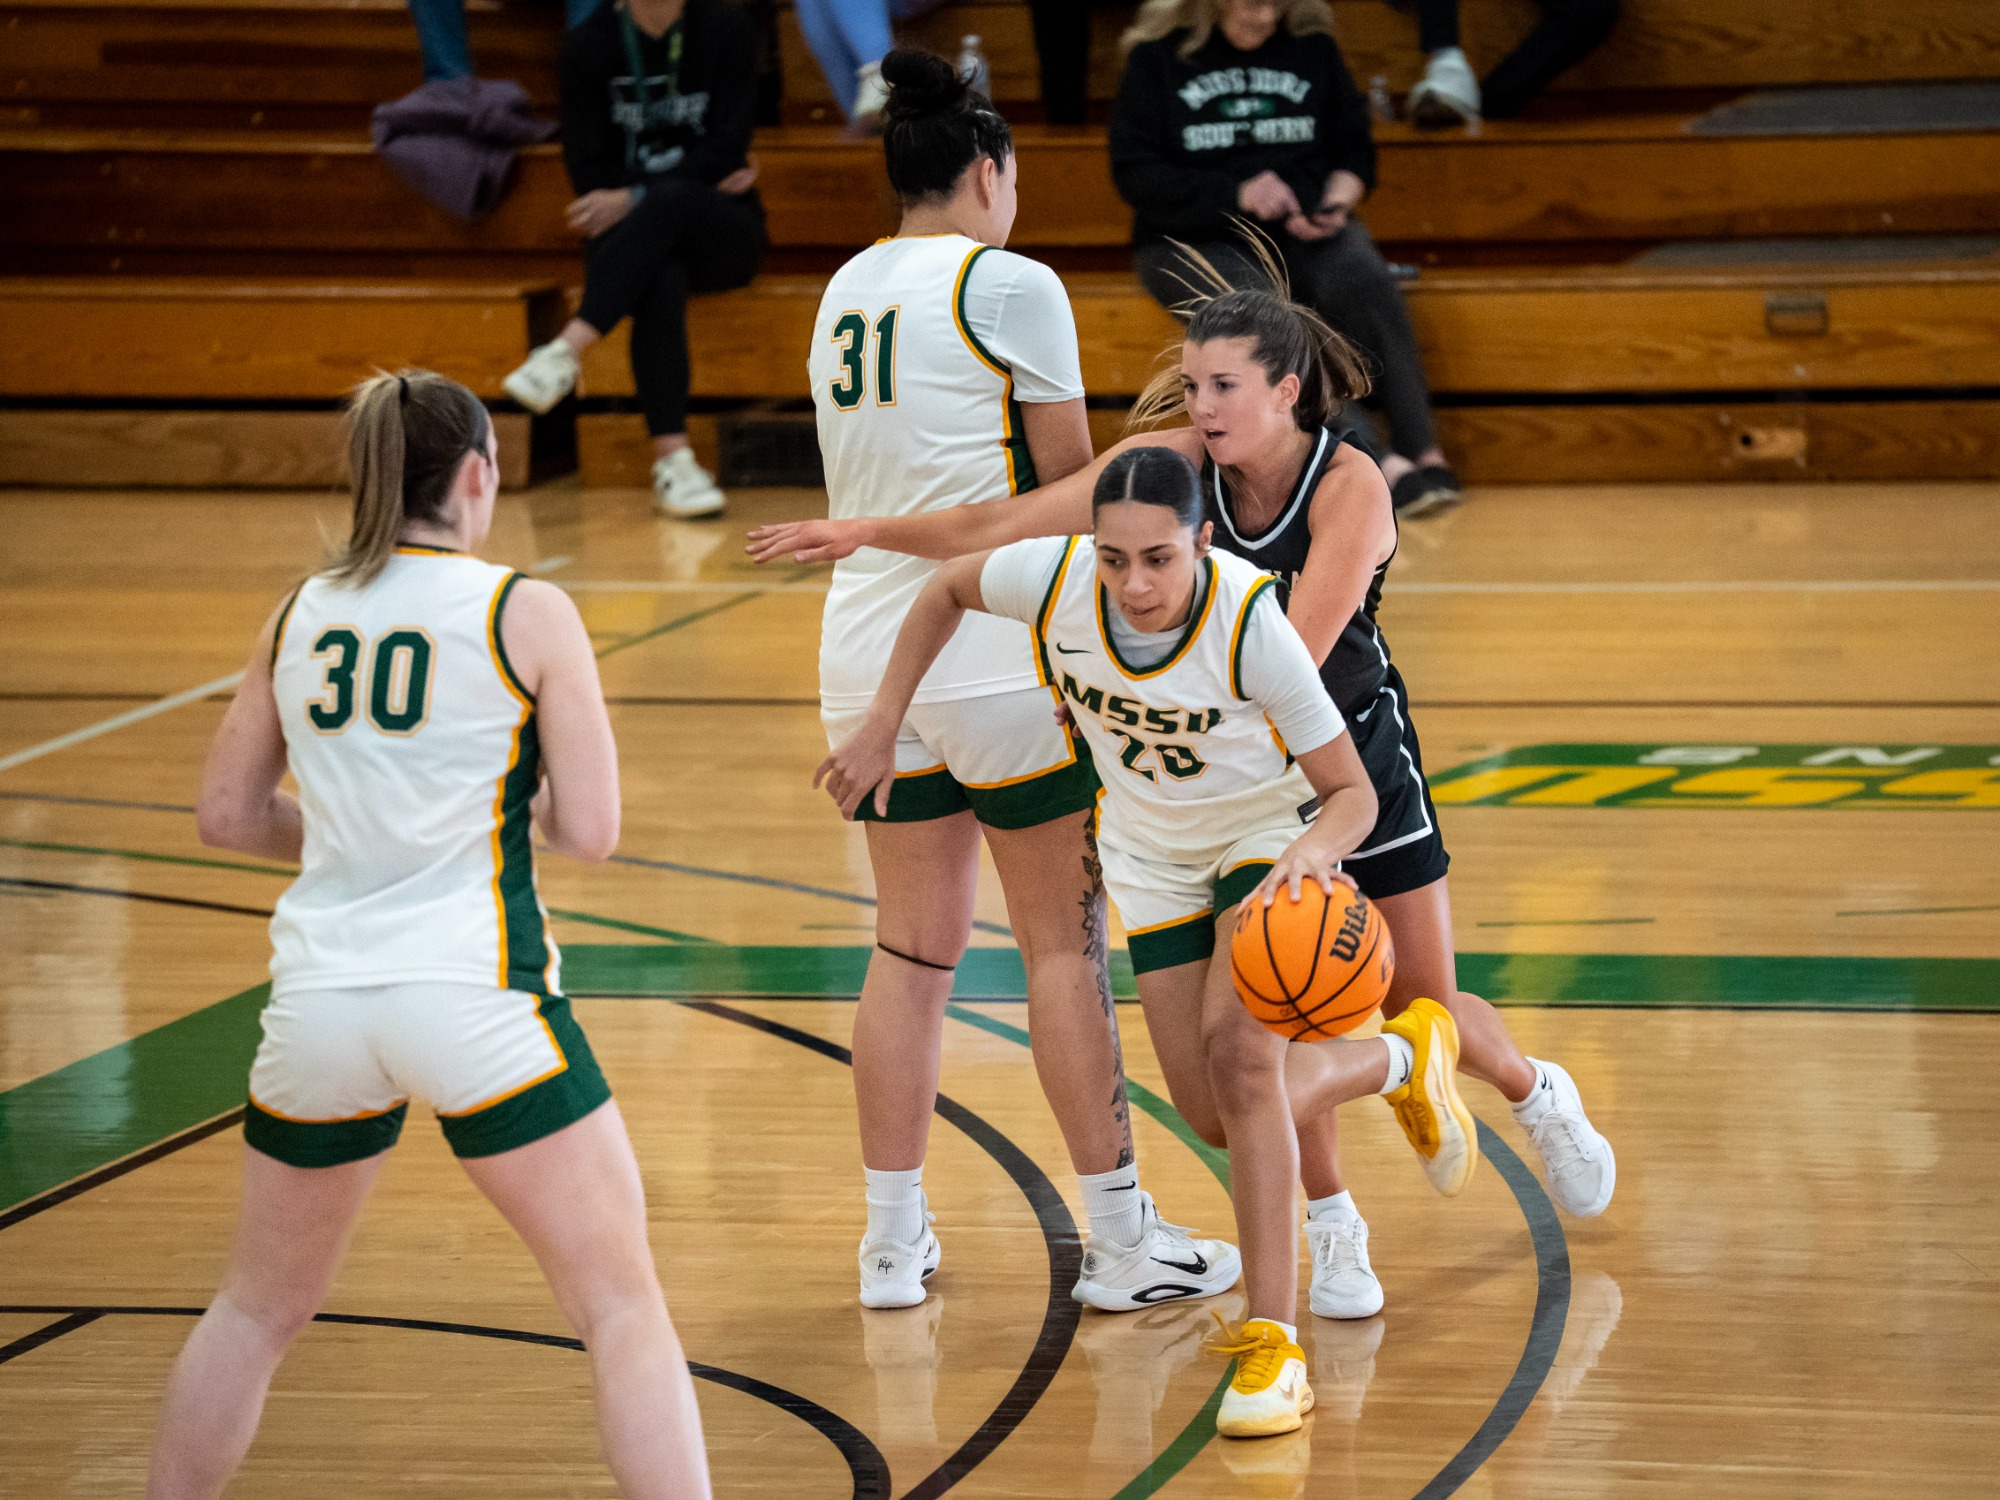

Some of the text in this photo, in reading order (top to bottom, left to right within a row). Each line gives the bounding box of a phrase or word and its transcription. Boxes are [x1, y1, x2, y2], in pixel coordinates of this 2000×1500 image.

[830, 304, 901, 412] 31
[304, 624, 438, 738] 30
[1062, 669, 1224, 736] MSSU
